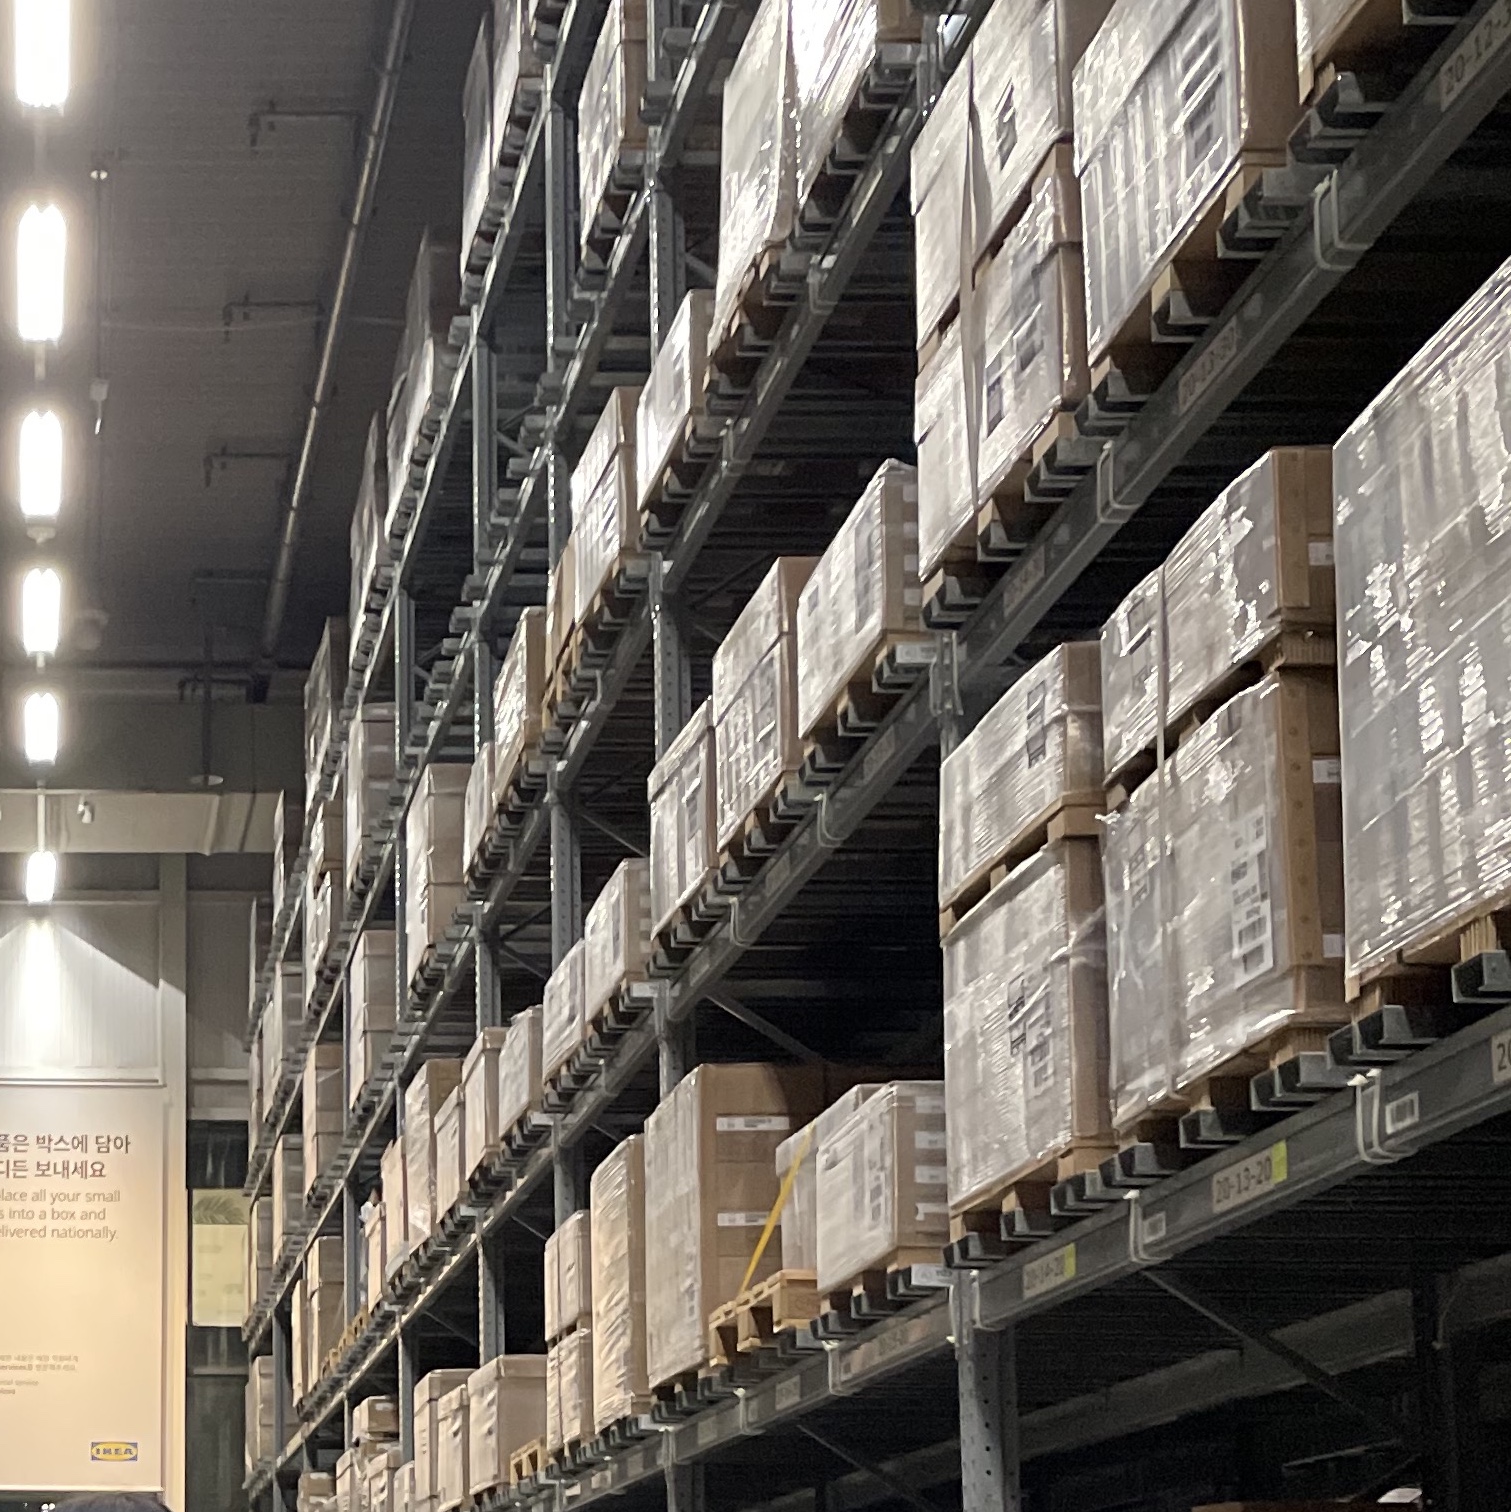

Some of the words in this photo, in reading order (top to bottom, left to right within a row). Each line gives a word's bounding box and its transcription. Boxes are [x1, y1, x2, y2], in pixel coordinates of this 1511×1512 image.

[36, 1134, 88, 1154] 박스에
[95, 1134, 131, 1154] 담아
[34, 1159, 106, 1180] 보내세요
[1215, 1154, 1273, 1204] 20-13-20
[32, 1189, 47, 1202] all
[50, 1191, 81, 1205] your
[85, 1189, 121, 1202] small
[9, 1208, 35, 1220] into
[39, 1210, 47, 1220] a
[52, 1207, 76, 1220] box
[80, 1208, 106, 1221] and
[51, 1226, 119, 1242] nationally.
